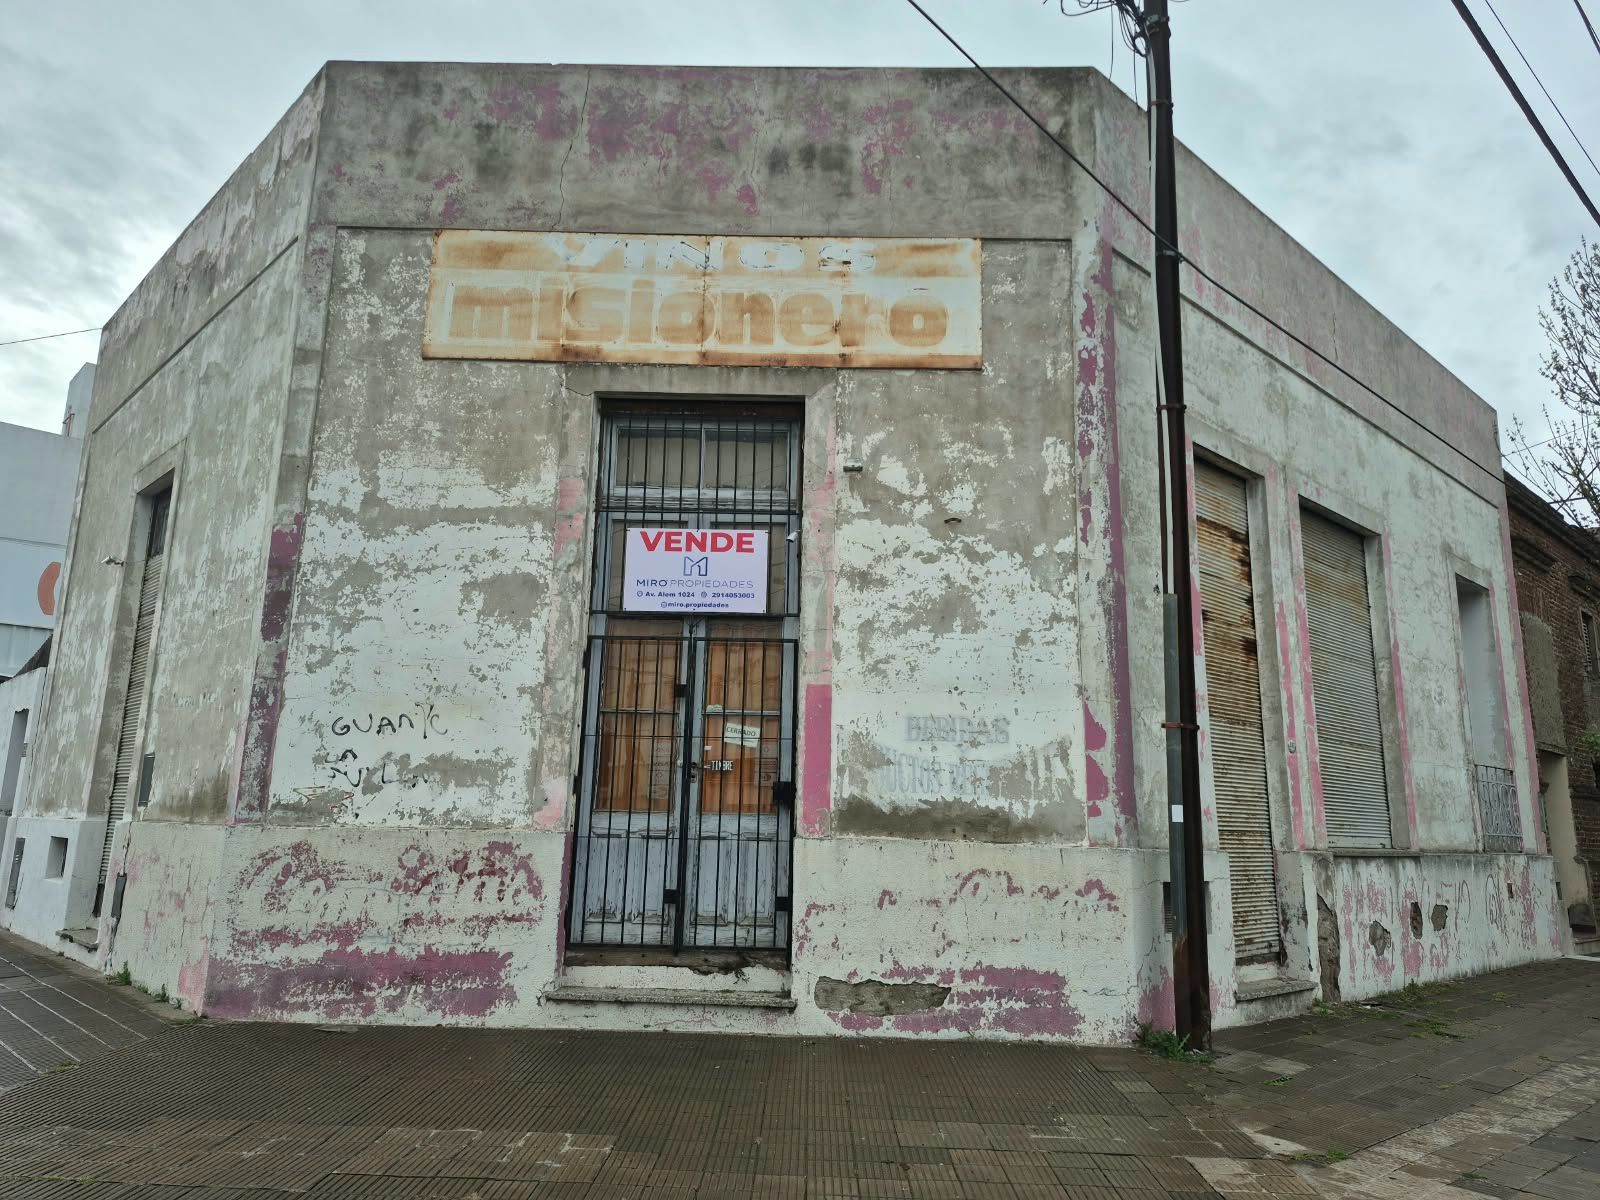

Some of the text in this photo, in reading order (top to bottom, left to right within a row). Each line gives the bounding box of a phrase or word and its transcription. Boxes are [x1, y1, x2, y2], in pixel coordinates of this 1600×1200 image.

[546, 235, 879, 273] VINOS
[640, 531, 755, 553] VENDE
[670, 579, 754, 589] PROPIEDADES
[726, 726, 756, 736] CERRADO
